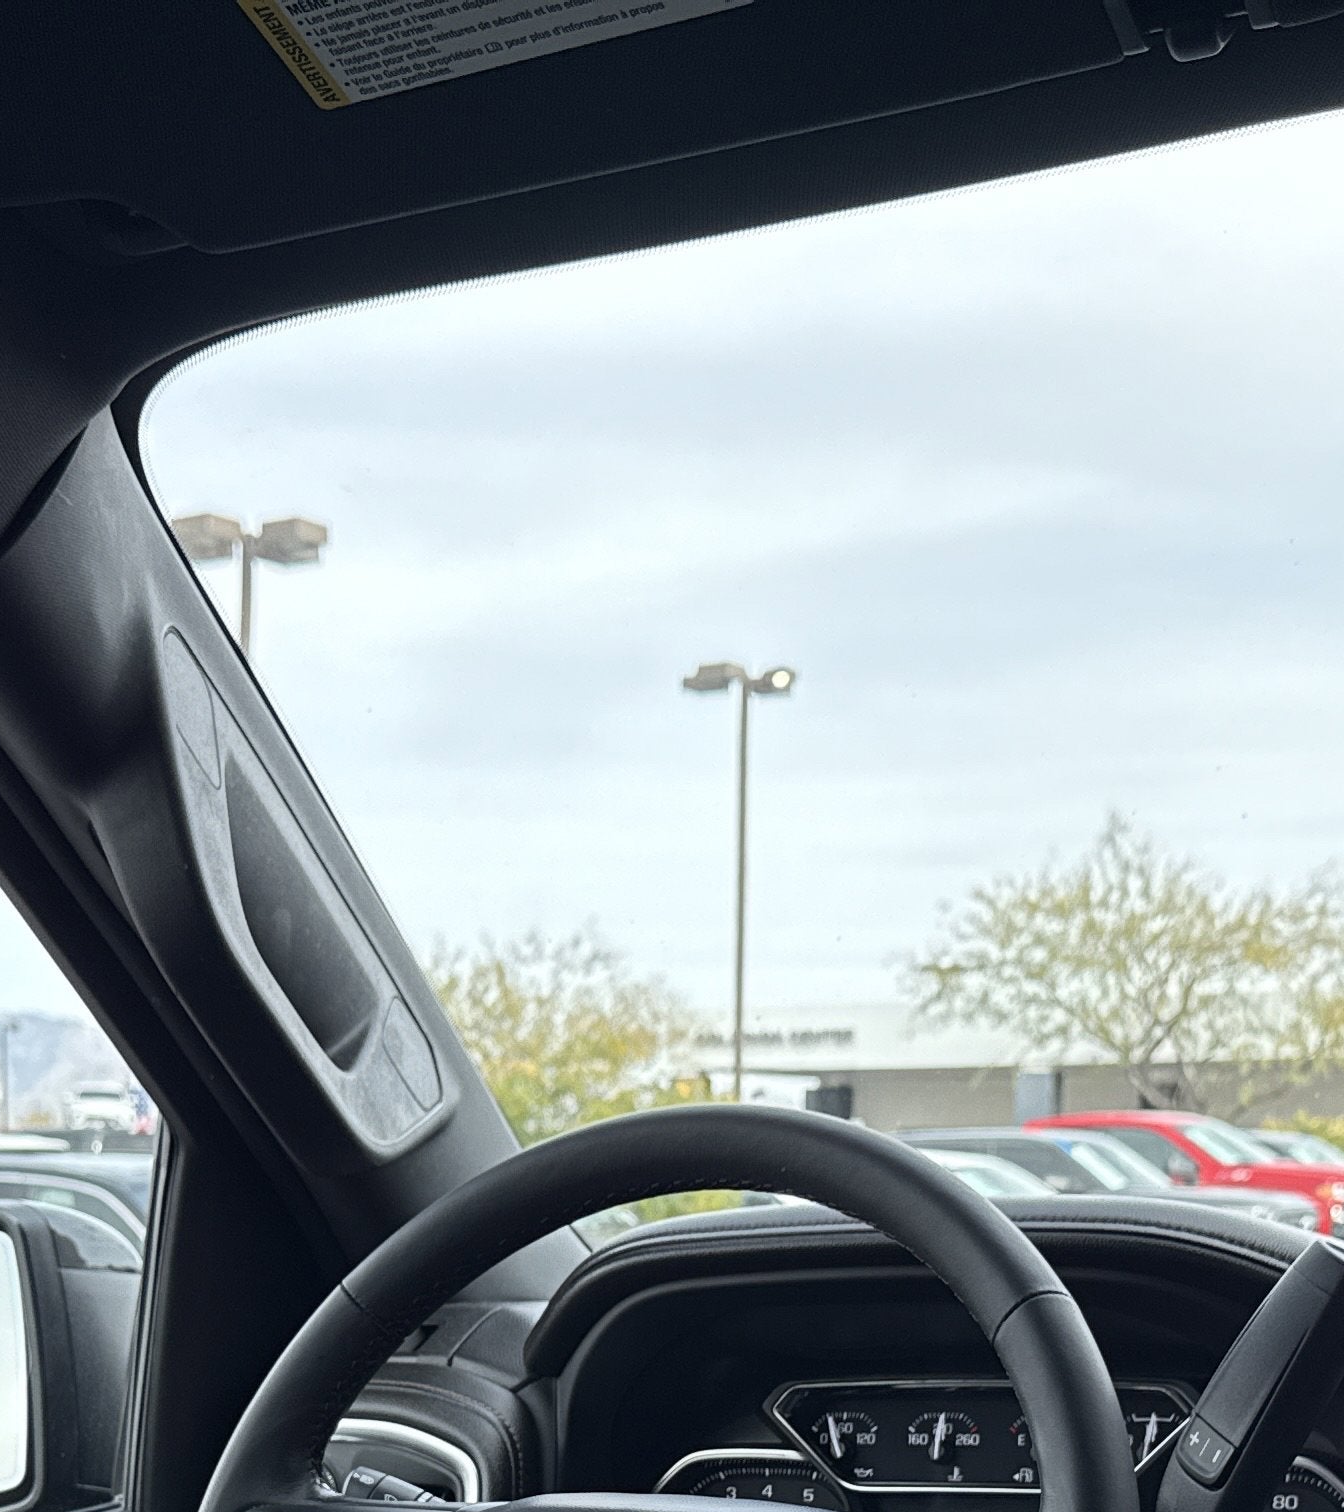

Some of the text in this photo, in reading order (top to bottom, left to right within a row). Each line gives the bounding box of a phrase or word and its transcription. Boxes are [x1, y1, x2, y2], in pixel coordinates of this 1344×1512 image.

[253, 5, 341, 103] AVERTISSEMENT
[856, 1433, 876, 1445] 120
[908, 1433, 928, 1446] 160
[956, 1433, 980, 1446] 260
[1017, 1434, 1026, 1446] E
[726, 1486, 737, 1499] 3
[761, 1484, 773, 1499] 4
[802, 1488, 814, 1503] 5
[1271, 1494, 1299, 1511] 80
